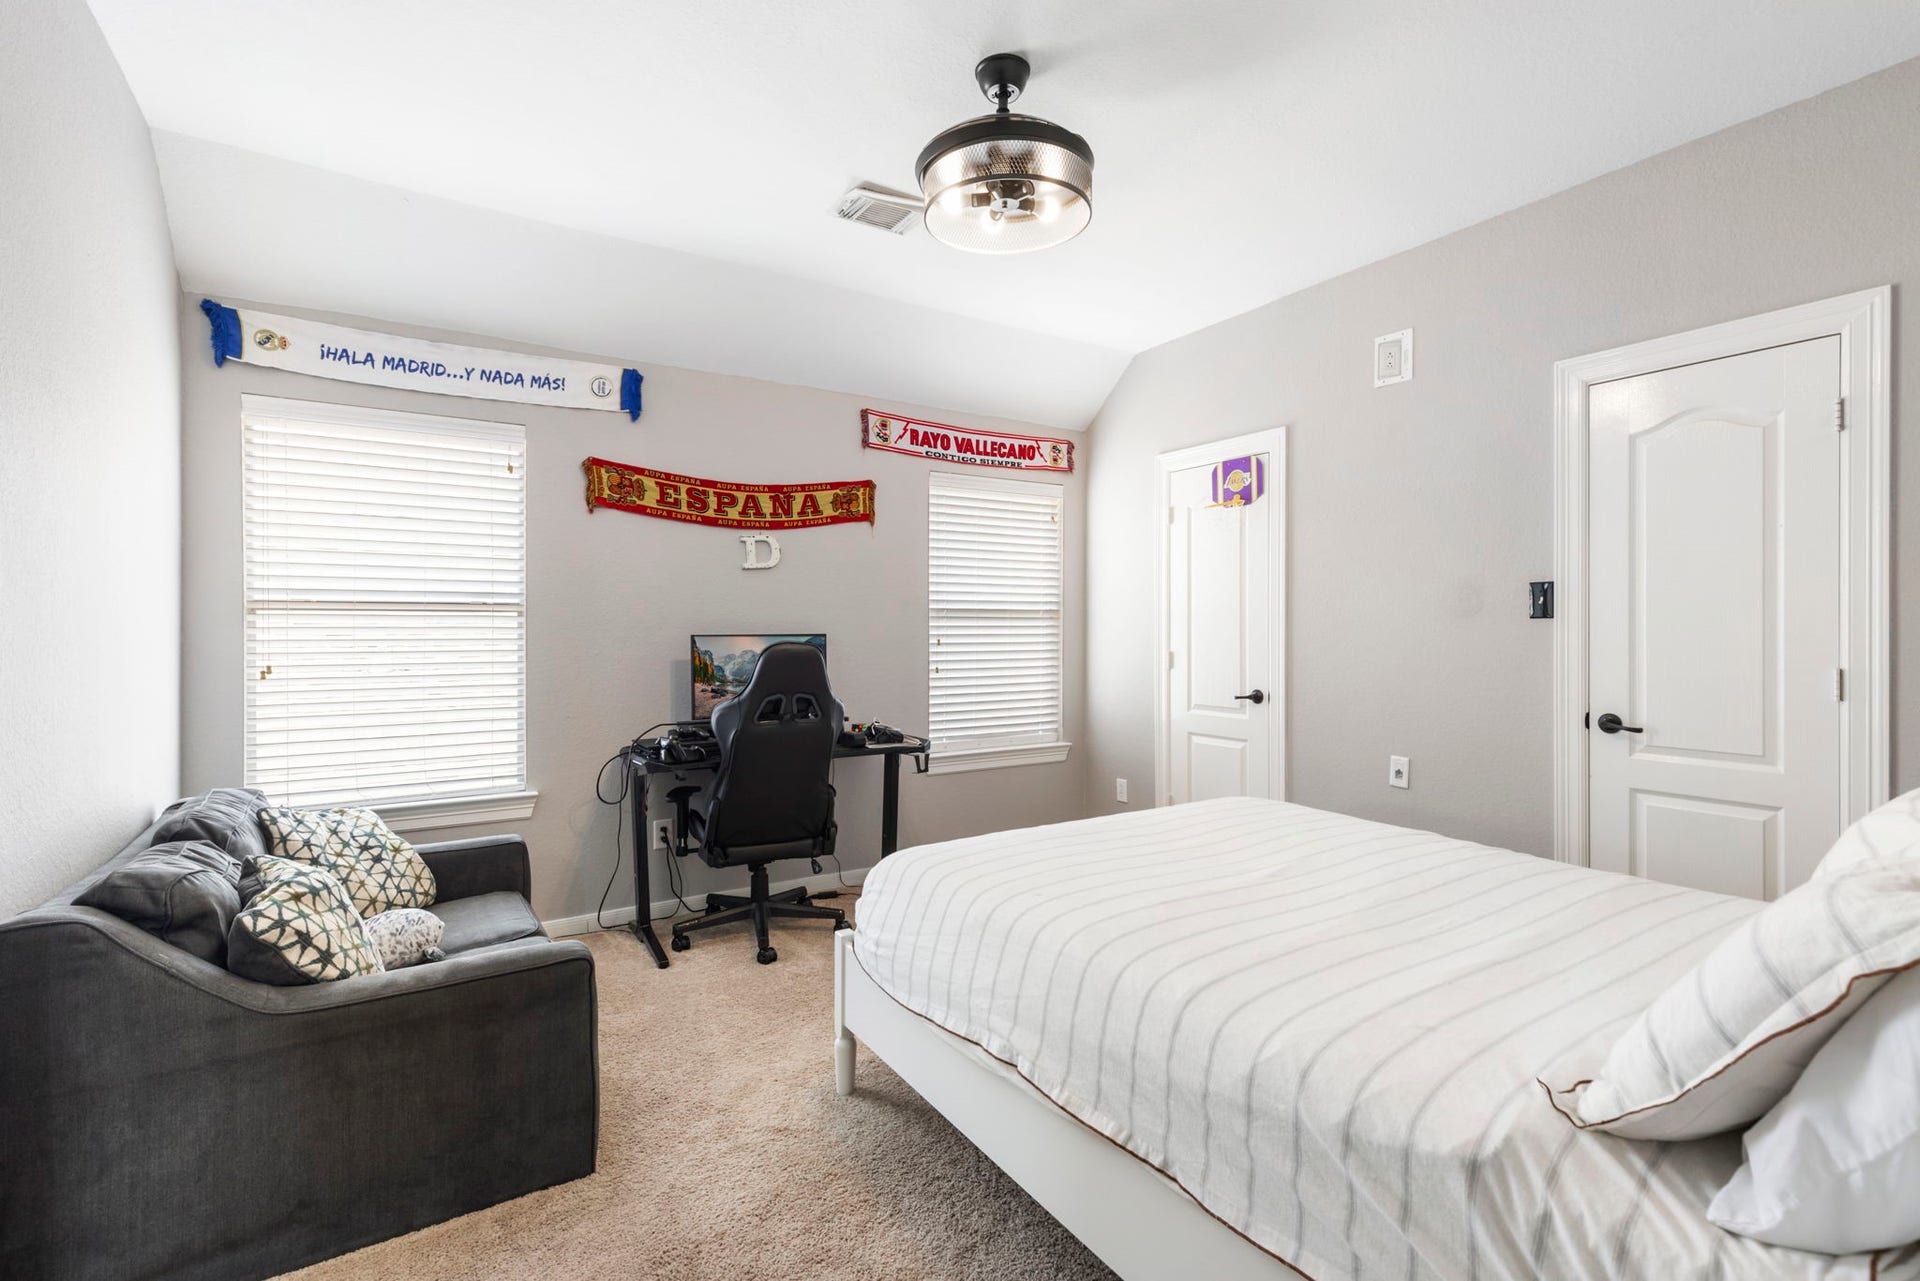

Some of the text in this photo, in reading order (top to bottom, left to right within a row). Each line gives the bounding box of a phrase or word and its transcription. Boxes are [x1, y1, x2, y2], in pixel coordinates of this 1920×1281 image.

[319, 344, 375, 370] ¡HALA
[480, 369, 525, 389] NADA
[530, 372, 567, 392] MÁS!
[910, 428, 951, 450] RAYO
[954, 436, 1036, 461] VALLECANO
[925, 450, 1023, 468] CONTIGO SIEMPRE
[644, 470, 665, 480] AUPA
[646, 507, 667, 517] AUPA
[655, 480, 823, 518] ESPAÑA
[740, 534, 782, 570] D
